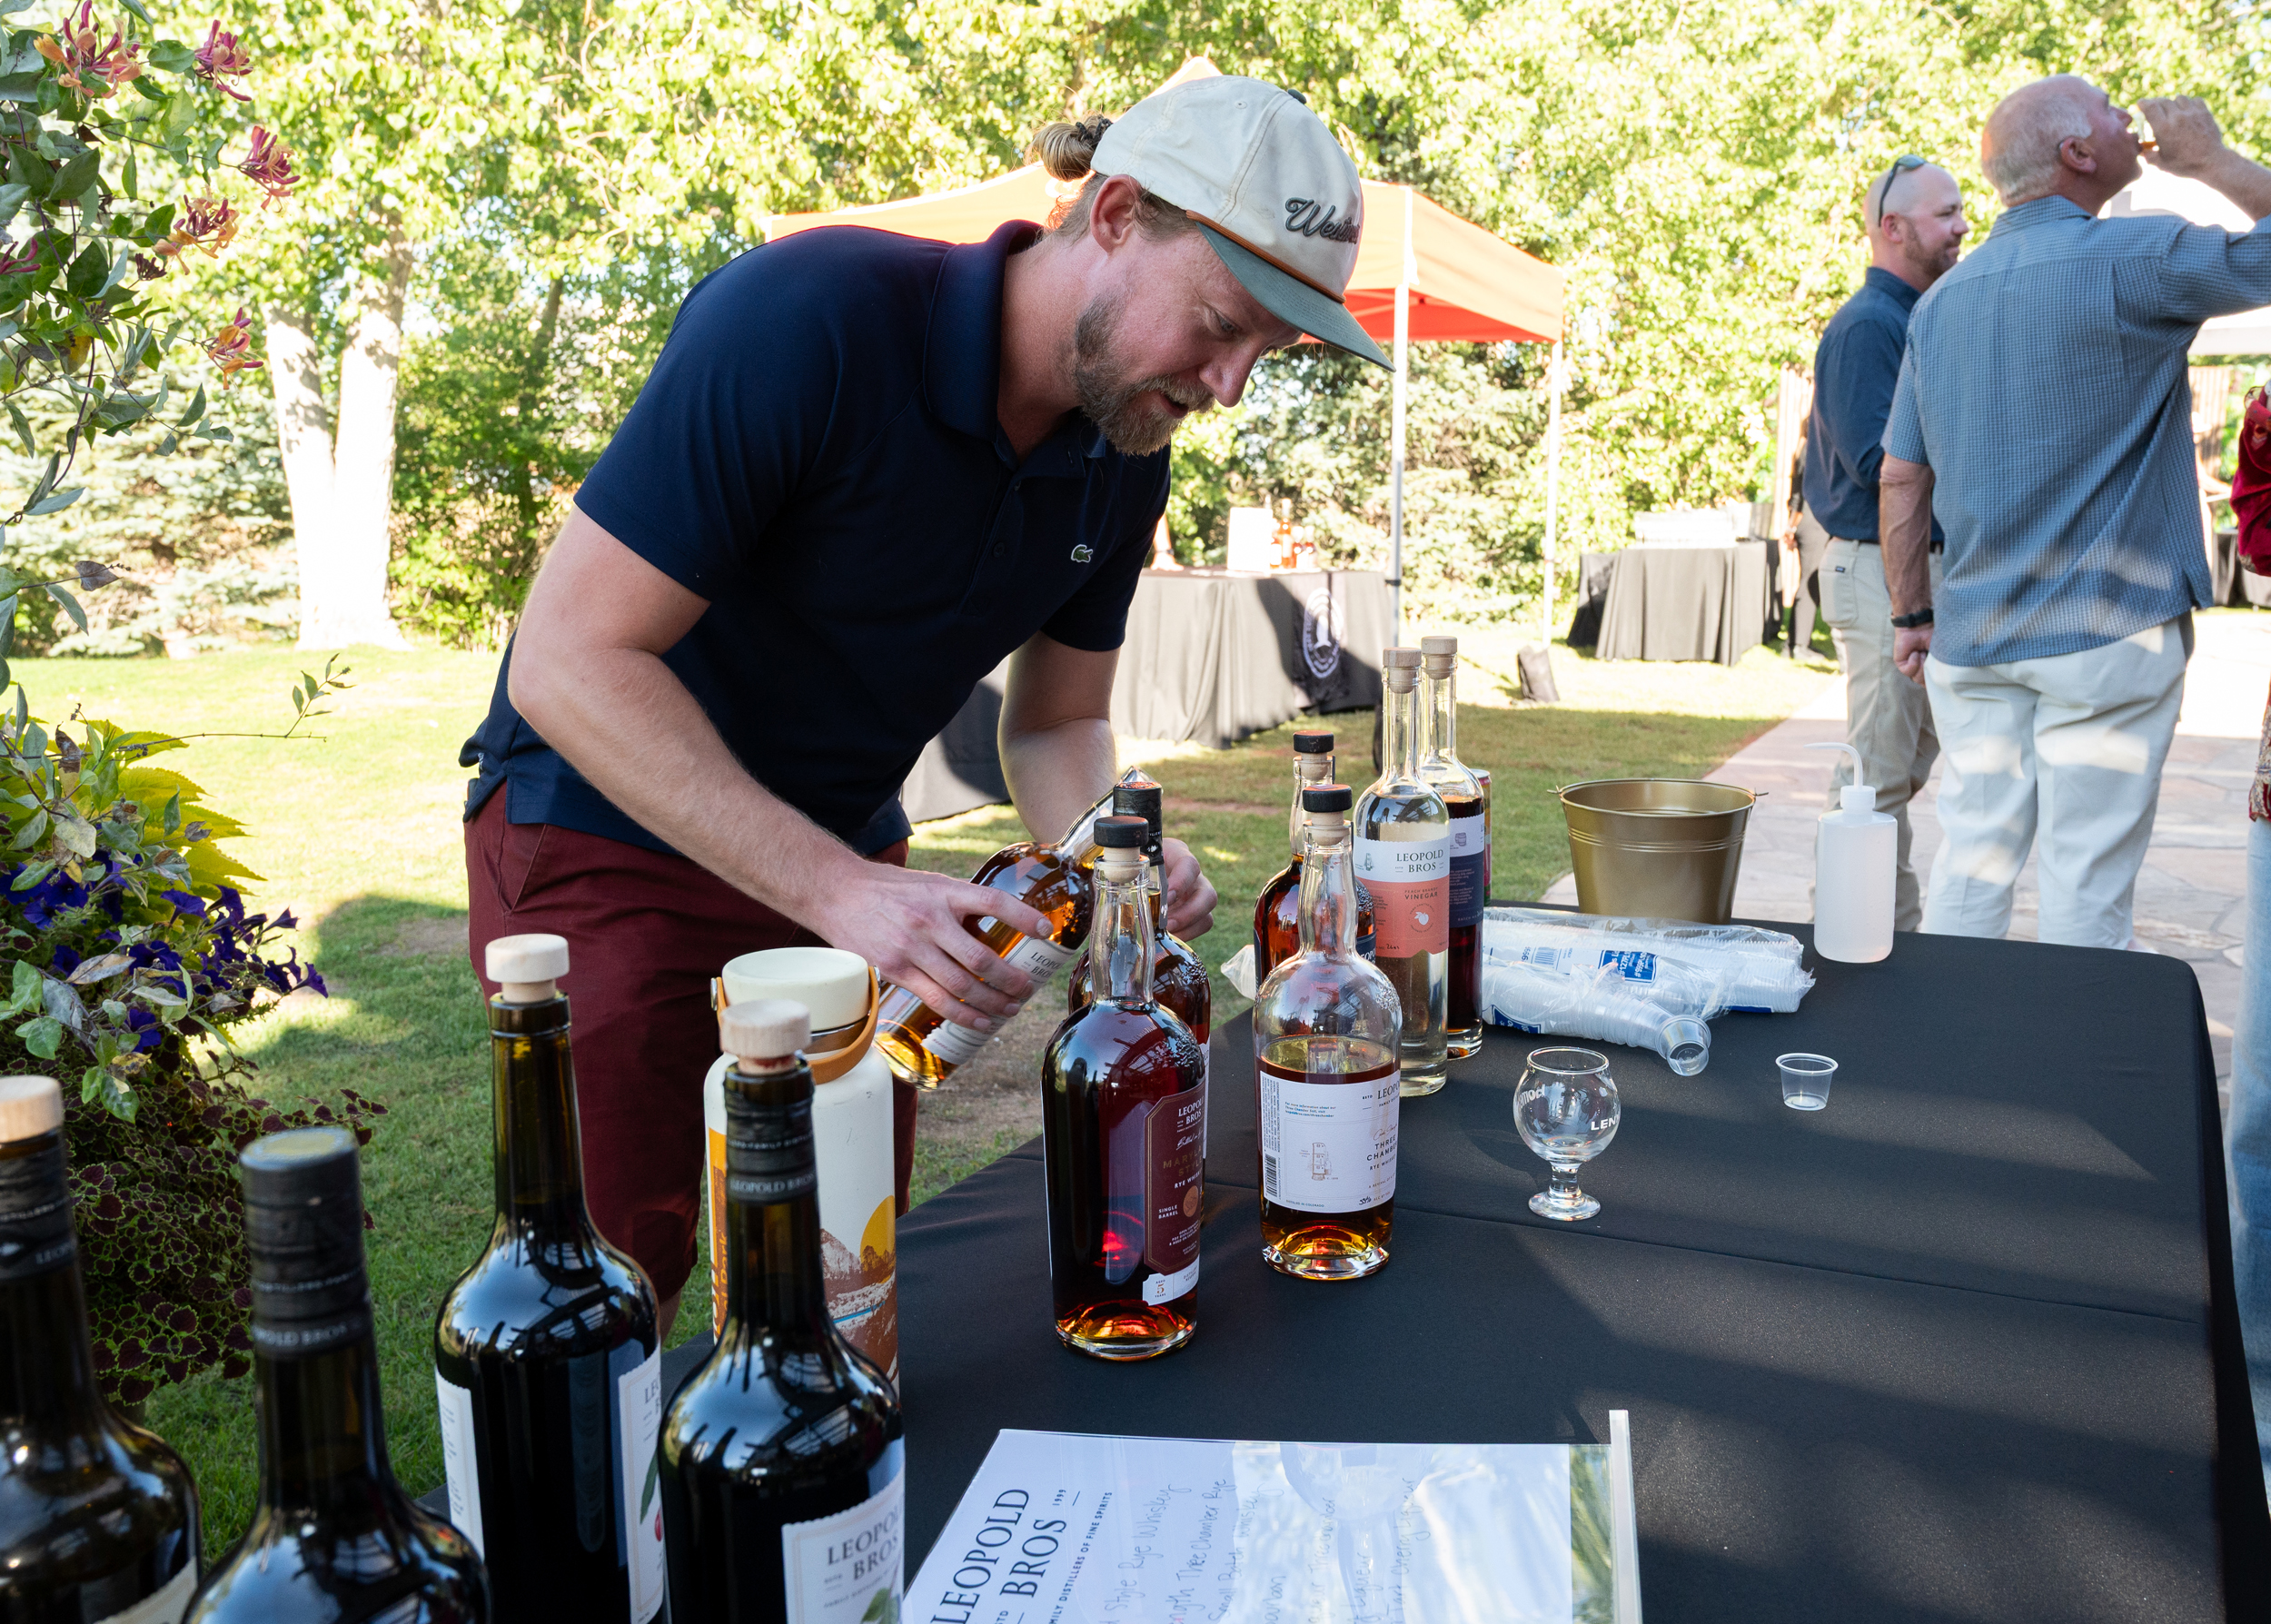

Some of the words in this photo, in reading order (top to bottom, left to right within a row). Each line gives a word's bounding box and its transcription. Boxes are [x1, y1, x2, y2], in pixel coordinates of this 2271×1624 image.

[1396, 849, 1443, 862] LEOPOLD
[1408, 862, 1436, 873] BROS
[1030, 952, 1058, 970] LEOPO
[1377, 1080, 1400, 1099] LEOPO
[1185, 1109, 1202, 1124] BROS
[1375, 1134, 1396, 1150] THREE
[1163, 1145, 1201, 1169] MARYLA
[1174, 1180, 1185, 1189] RYE
[1158, 1204, 1178, 1213] SINGLE
[1158, 1211, 1178, 1219] BARREL
[1156, 1283, 1165, 1294] 5
[1052, 1489, 1066, 1506] 1999
[1202, 1479, 1237, 1499] Rye
[1132, 1483, 1192, 1538] Whiskey
[1233, 1482, 1284, 1538] Whiskey
[1393, 1478, 1423, 1529] Liqueur
[828, 1505, 898, 1566] LEOPOL
[1190, 1505, 1219, 1550] Chamber
[930, 1489, 1029, 1624] LEOPOLD
[999, 1519, 1066, 1598] BROS
[1048, 1605, 1064, 1624] MILY
[1059, 1556, 1085, 1601] DISTILLERS
[1081, 1542, 1091, 1553] OF
[1086, 1520, 1099, 1540] FINE
[1095, 1491, 1112, 1520] SPIRITS
[1117, 1545, 1164, 1569] Rye
[1218, 1547, 1245, 1581] Batch
[1391, 1530, 1431, 1575] Cherry
[1175, 1552, 1207, 1581] Three
[1340, 1552, 1383, 1607] Liqueur
[1105, 1579, 1145, 1611] Style
[1208, 1587, 1236, 1621] Small
[994, 1610, 1008, 1624] STD
